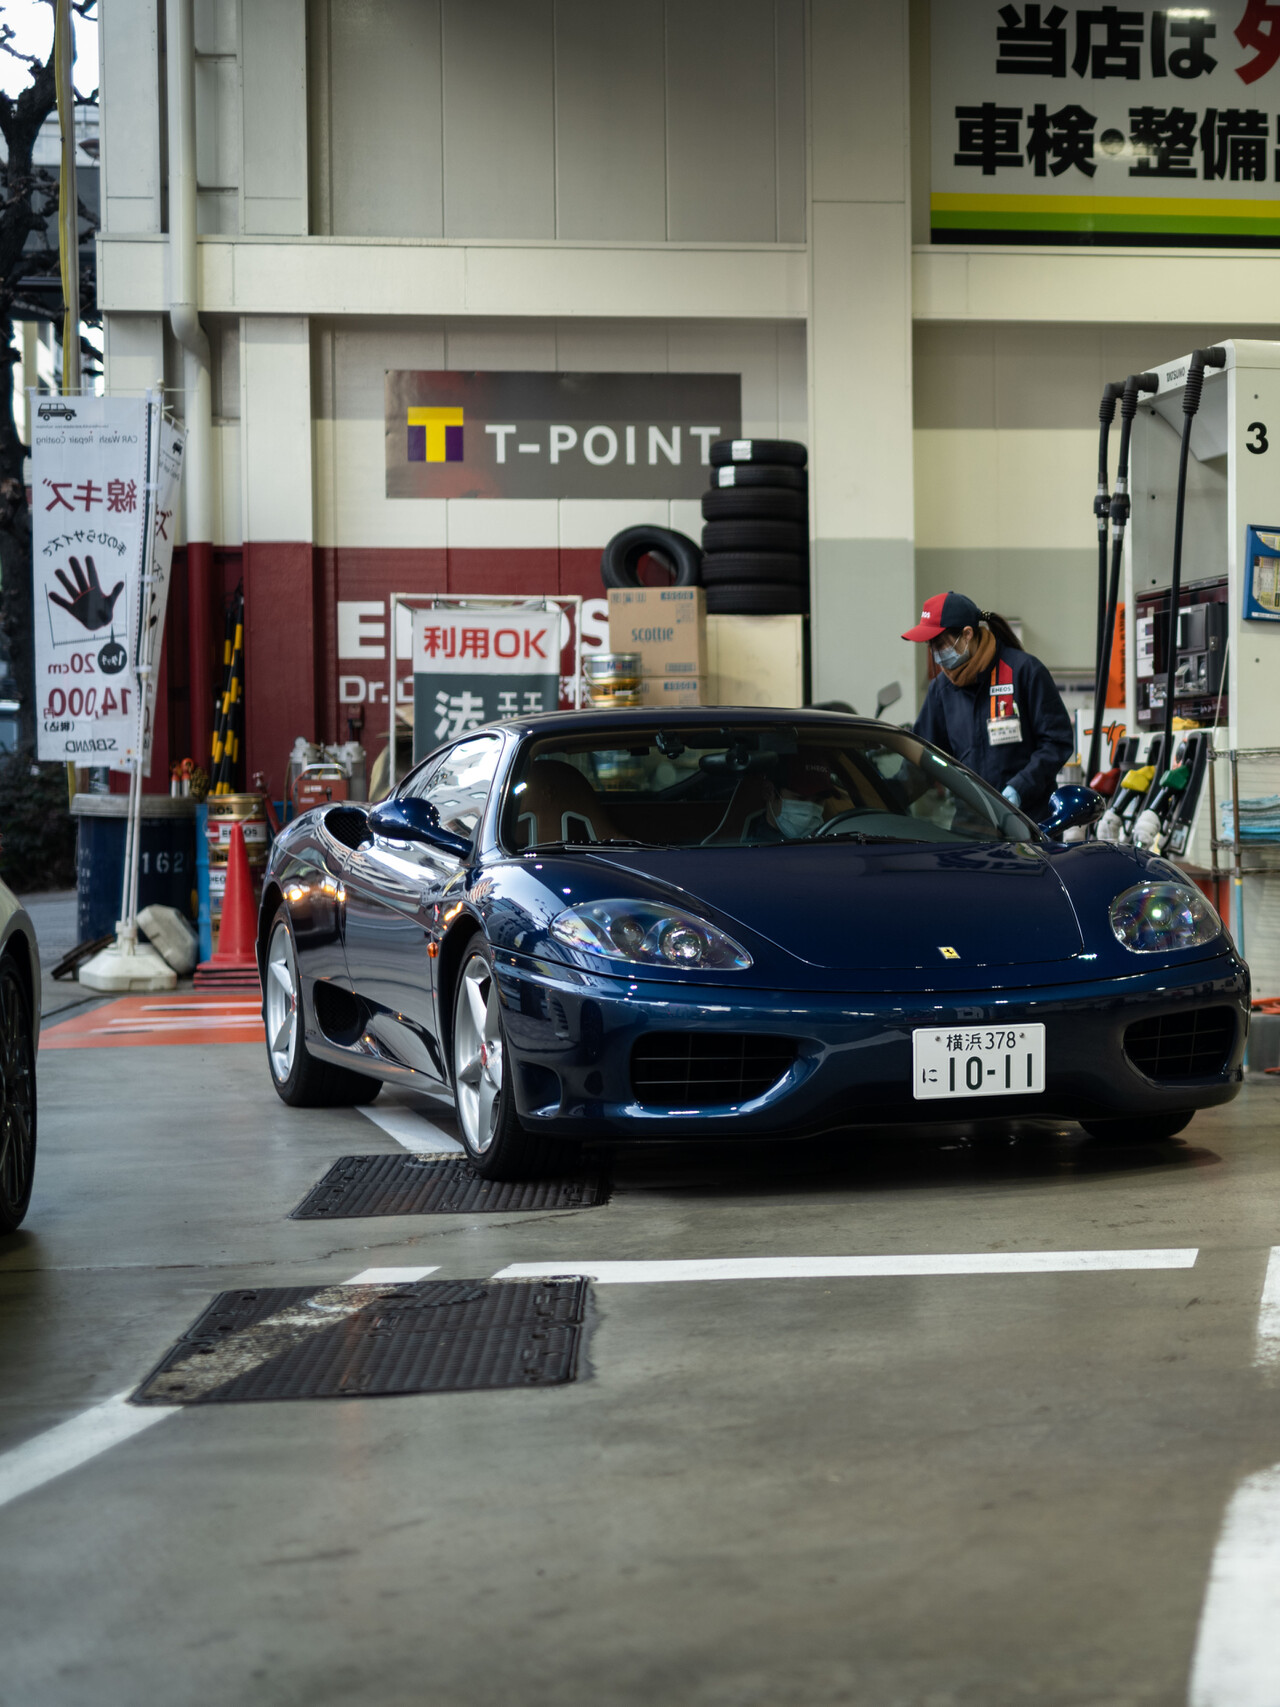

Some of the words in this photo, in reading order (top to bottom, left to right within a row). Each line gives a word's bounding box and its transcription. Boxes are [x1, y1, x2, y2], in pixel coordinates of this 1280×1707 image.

[485, 424, 722, 467] T-POINT
[1245, 421, 1269, 454] 3
[424, 626, 548, 659] 利用OK
[631, 626, 674, 642] scottie
[222, 827, 257, 837] EOS
[922, 1068, 938, 1084] に
[949, 1053, 1033, 1092] 10-11
